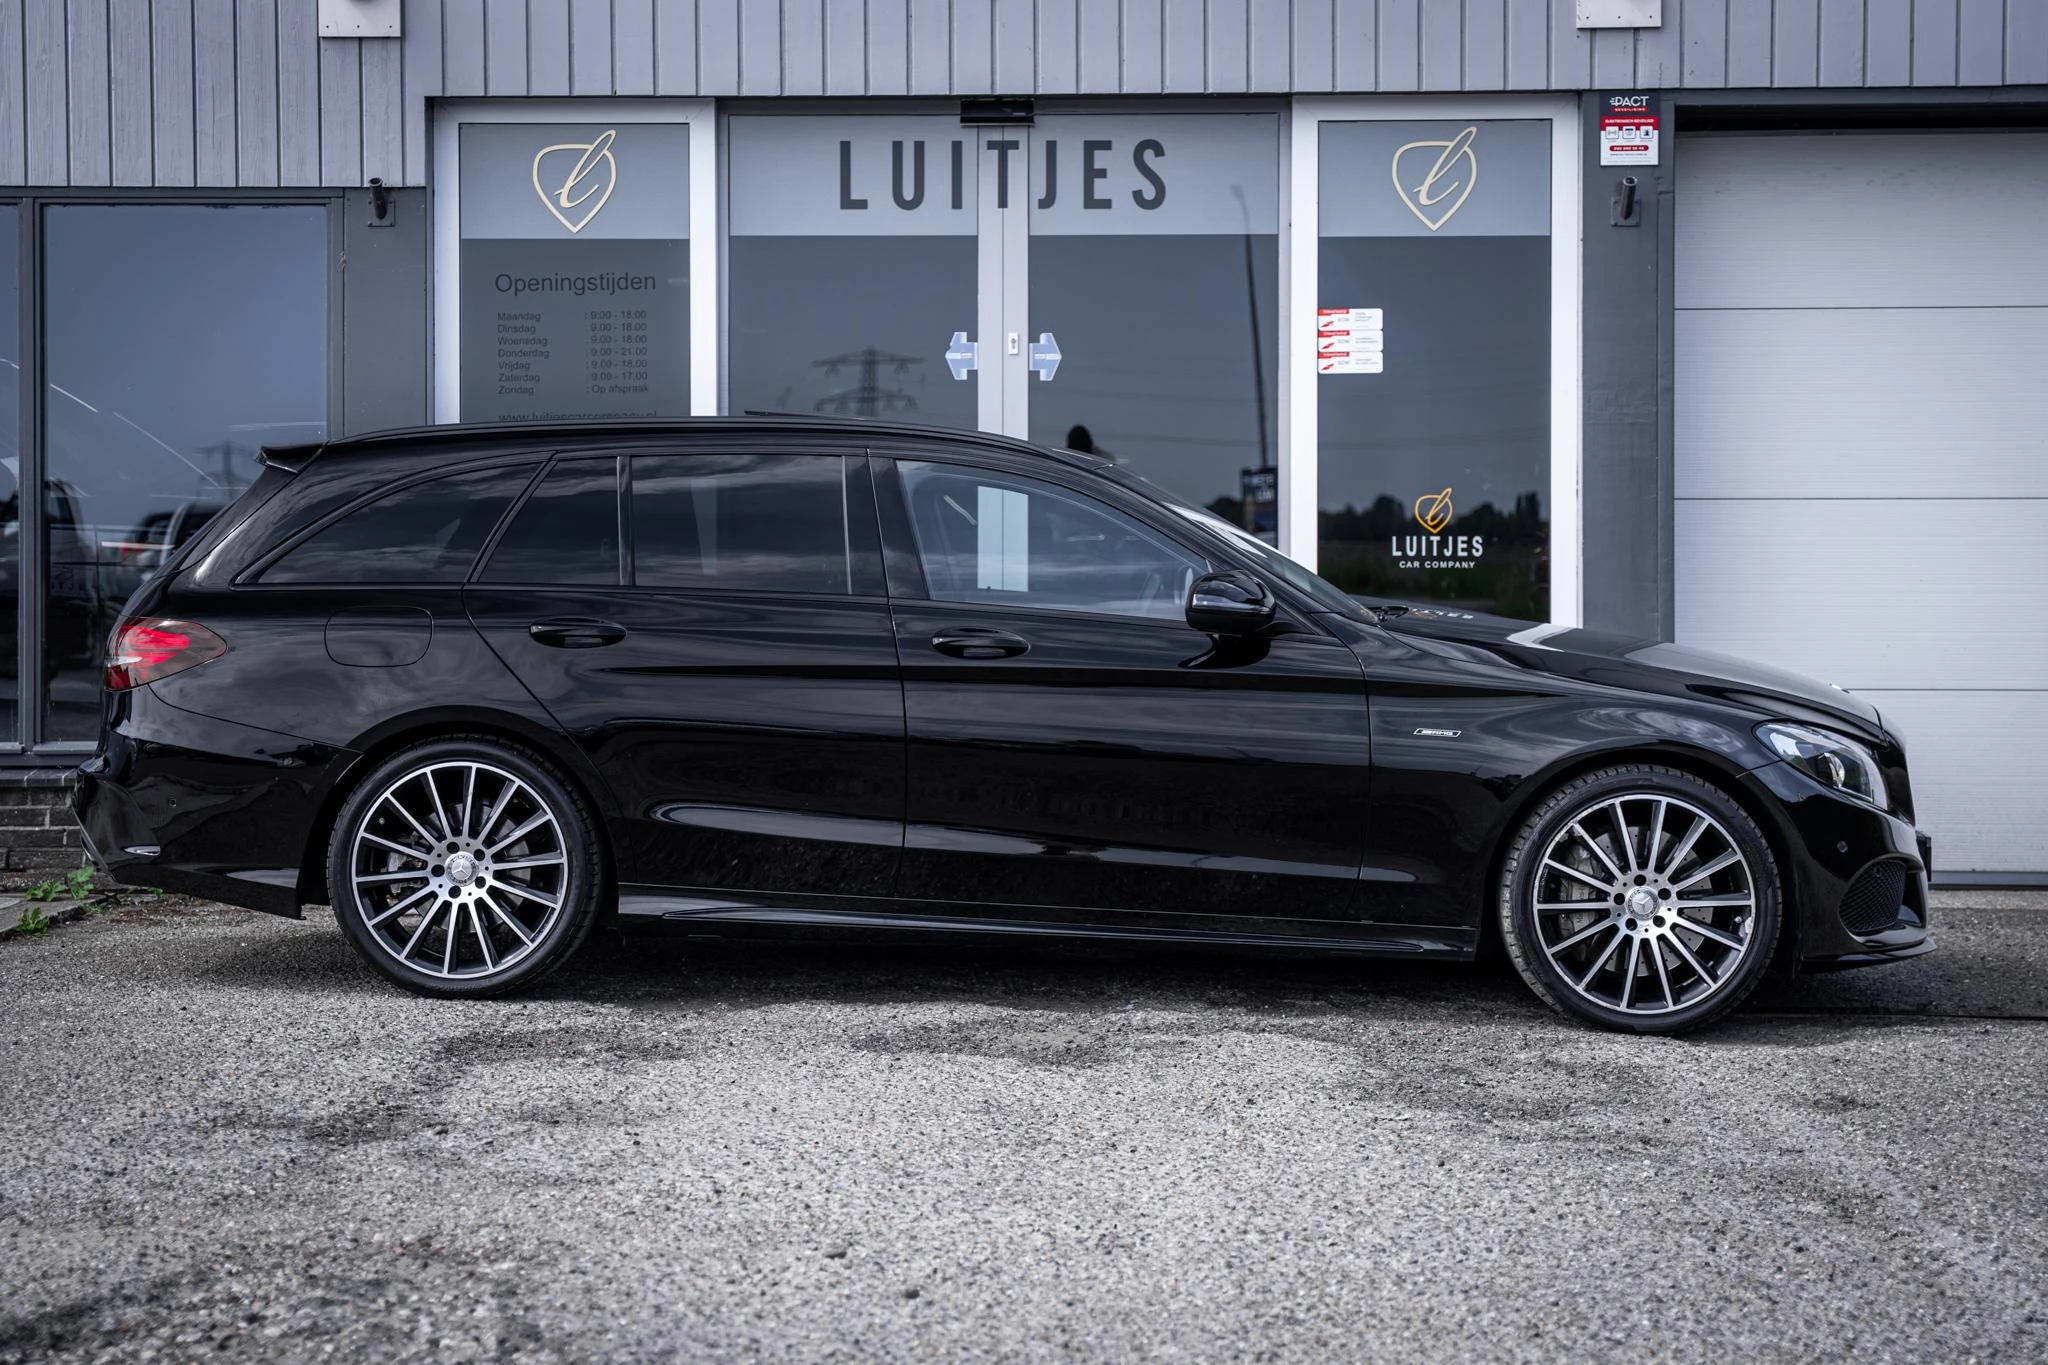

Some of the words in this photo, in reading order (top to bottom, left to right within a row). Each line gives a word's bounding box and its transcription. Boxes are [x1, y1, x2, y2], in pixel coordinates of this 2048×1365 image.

[840, 139, 1166, 211] LUITJES
[495, 272, 656, 296] Openingstijden
[497, 311, 542, 322] Maandag
[497, 324, 536, 335] Dinsdag
[497, 336, 548, 347] Woensdag
[497, 349, 550, 360] Donderdag
[497, 361, 531, 371] Vrijdag
[498, 373, 541, 384] Zaterdag
[498, 385, 534, 396] Zondag
[592, 384, 606, 394] Op
[1392, 536, 1483, 557] LUITJES
